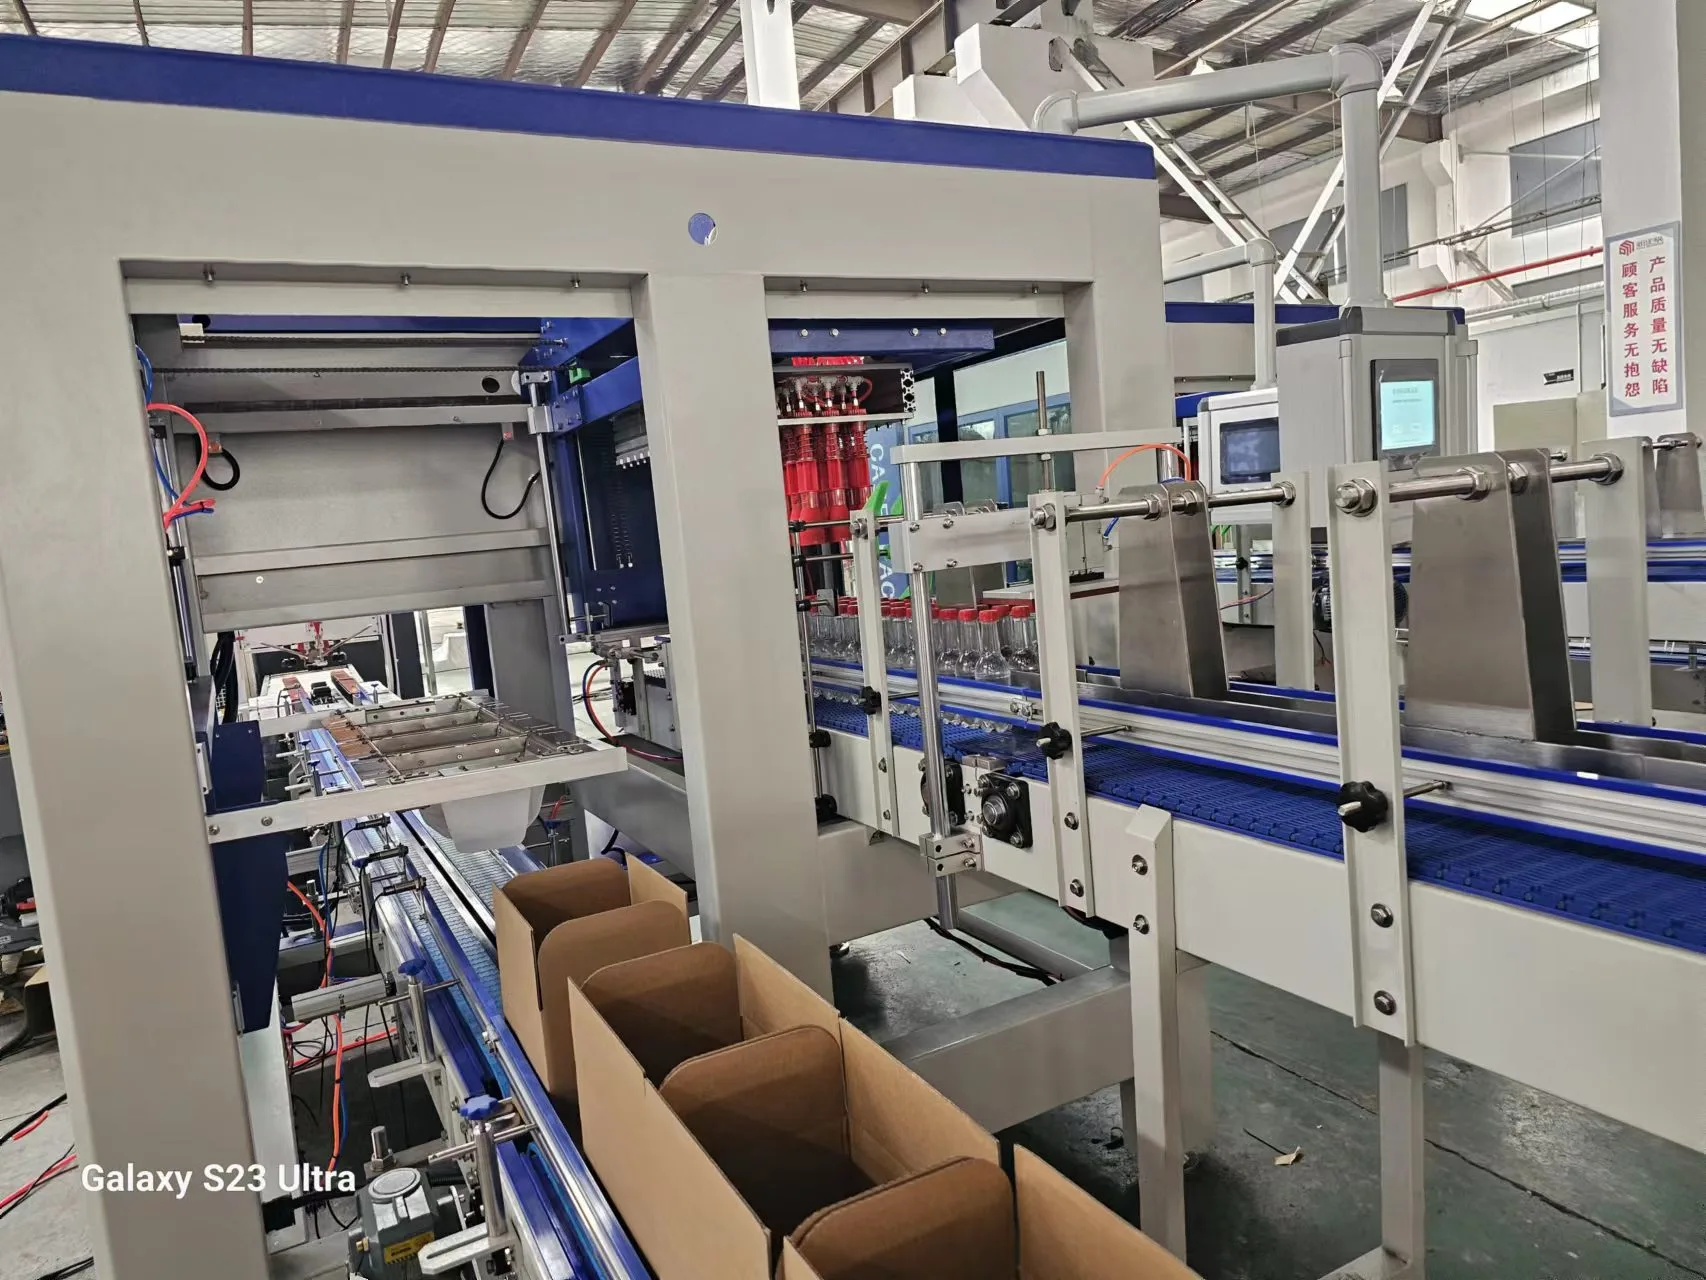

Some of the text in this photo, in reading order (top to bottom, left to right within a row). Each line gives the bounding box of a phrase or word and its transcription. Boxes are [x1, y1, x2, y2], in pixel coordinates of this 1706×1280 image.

[1621, 261, 1640, 397] 顾客服务无抱怨
[1649, 255, 1668, 395] 产品质量无缺陷
